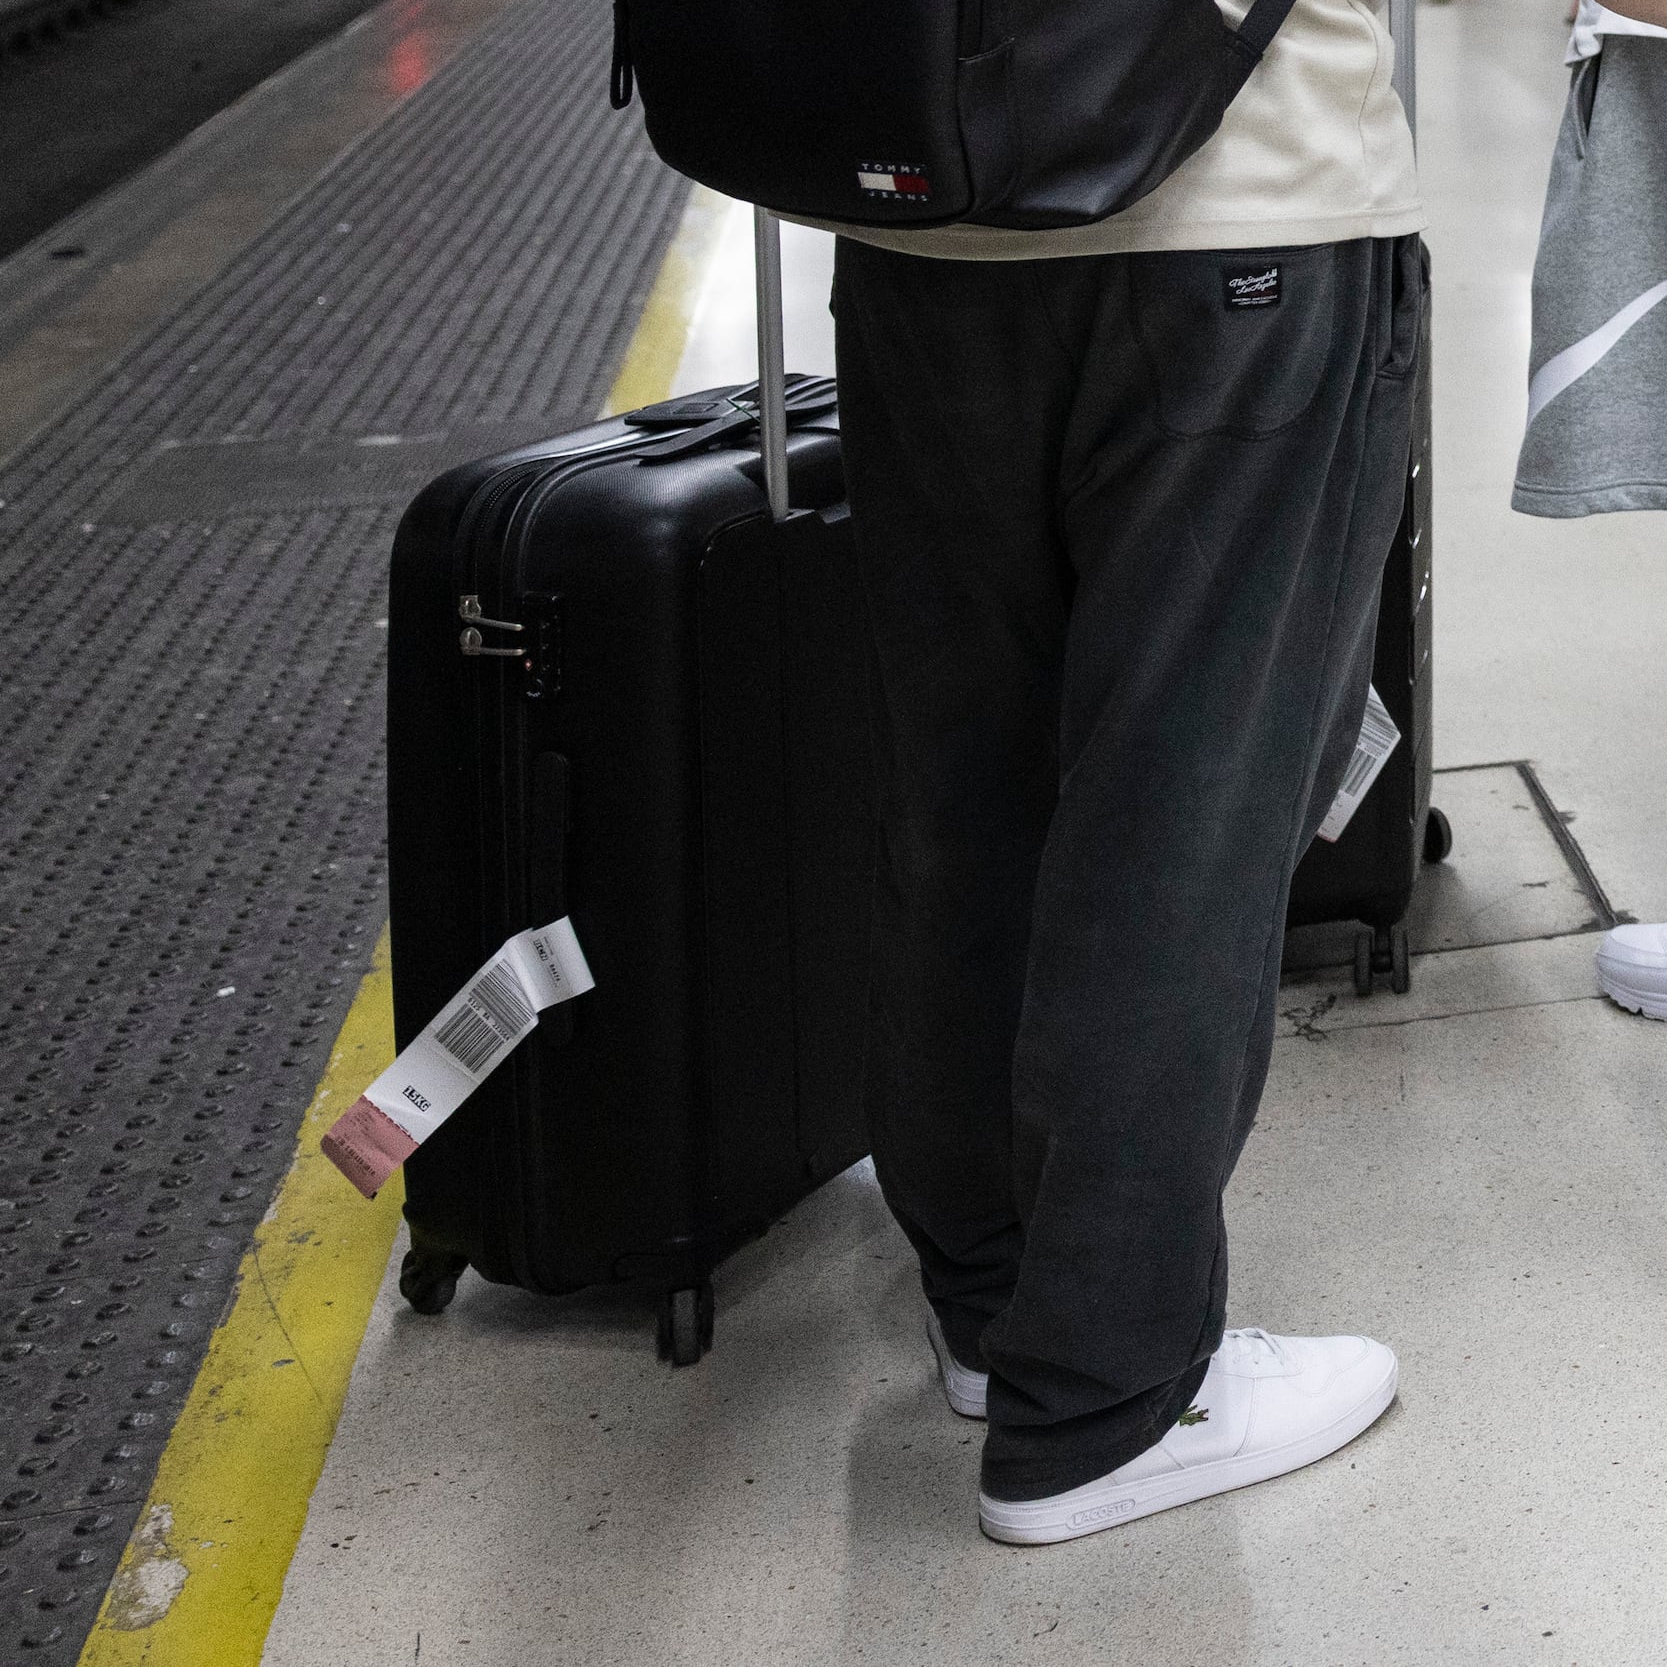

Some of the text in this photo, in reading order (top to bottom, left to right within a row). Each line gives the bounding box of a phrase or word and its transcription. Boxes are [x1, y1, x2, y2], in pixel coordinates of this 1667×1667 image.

[861, 162, 921, 174] TOMMY
[869, 191, 928, 202] JEANS
[402, 1085, 432, 1112] 15KG
[1073, 1501, 1131, 1526] LACOSTE
